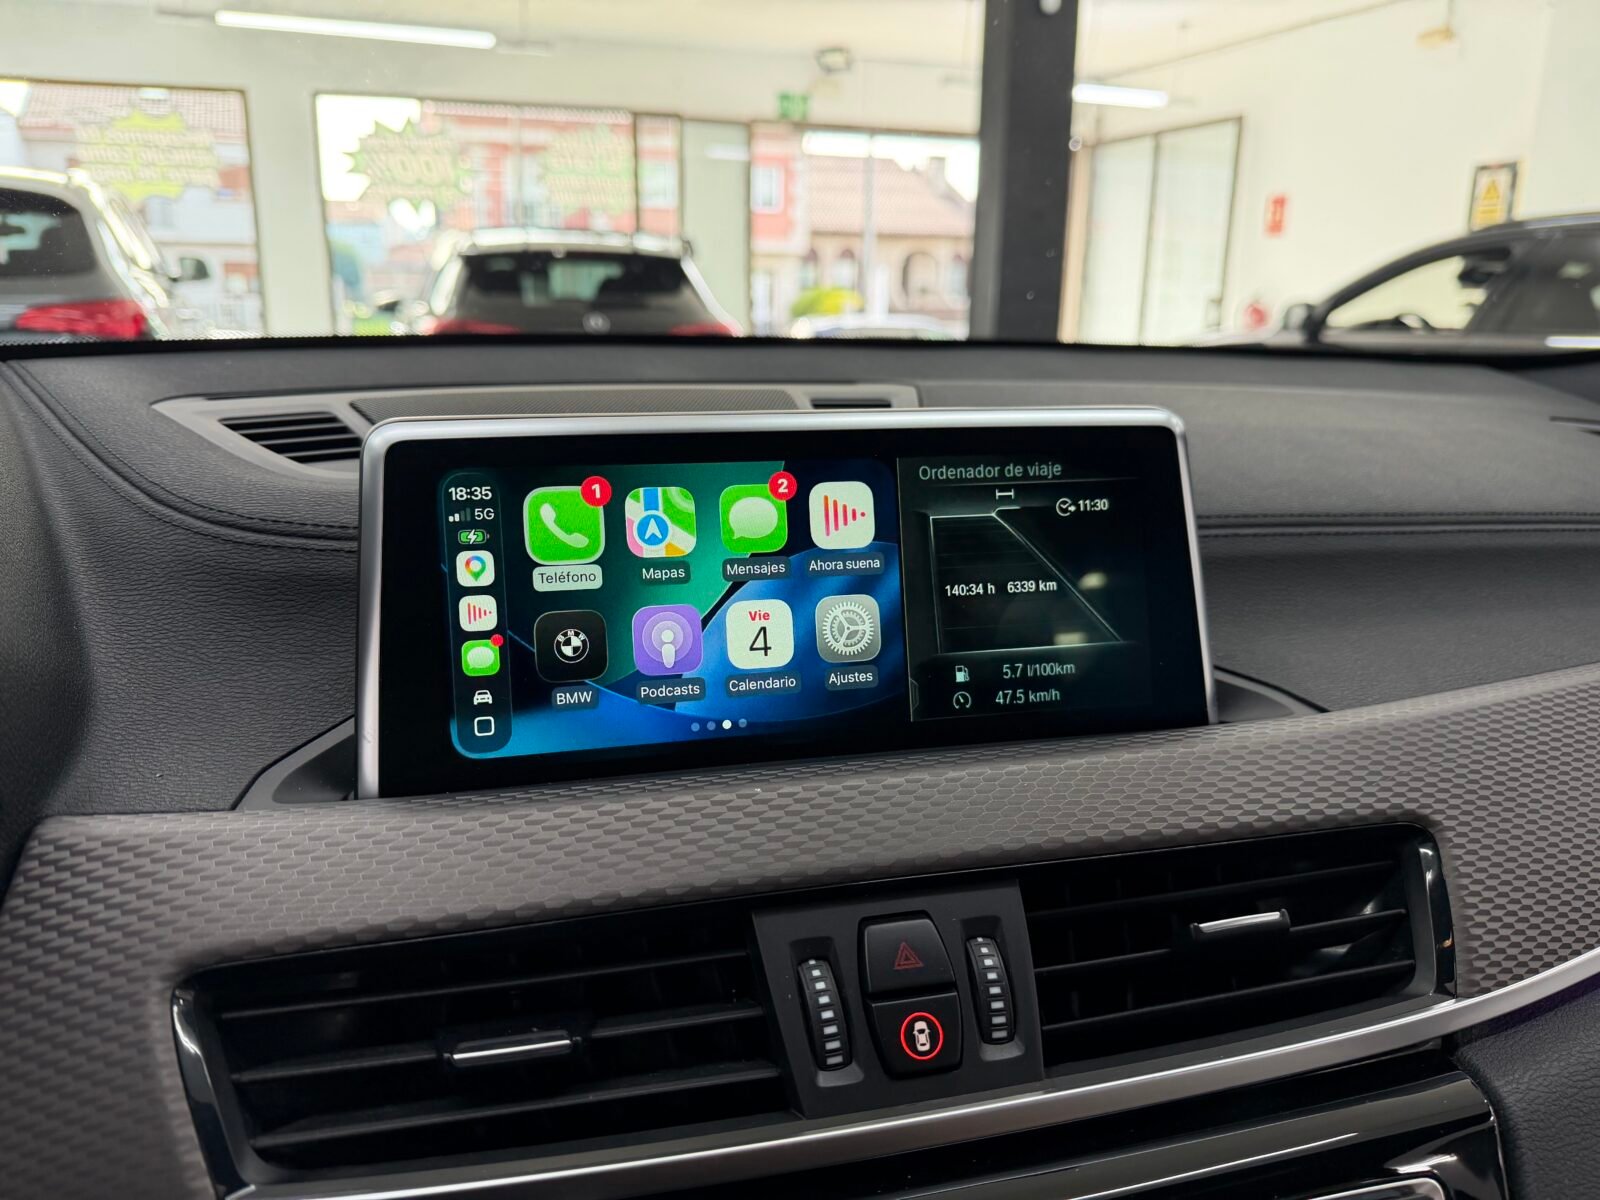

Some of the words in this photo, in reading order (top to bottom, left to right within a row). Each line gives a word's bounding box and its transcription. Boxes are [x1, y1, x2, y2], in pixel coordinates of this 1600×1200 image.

[918, 465, 1000, 481] Ordenador
[1004, 463, 1023, 478] de
[1027, 461, 1062, 479] viaje
[591, 483, 601, 499] 1
[777, 478, 789, 493] 2
[448, 486, 493, 501] 18:35
[1077, 498, 1109, 512] 11:30
[474, 508, 495, 520] 5G
[726, 562, 786, 577] Mensajes
[809, 558, 844, 571] Ahora
[845, 558, 881, 570] suena
[538, 572, 597, 585] Teléfono
[642, 567, 686, 582] Mapas
[945, 584, 984, 597] 140:34
[987, 583, 996, 595] h
[1007, 580, 1036, 593] 6339
[1038, 579, 1058, 592] km
[748, 609, 771, 622] Vie
[749, 626, 772, 657] 4
[828, 670, 874, 686] Ajustes
[1002, 663, 1024, 679] 5.7
[1026, 662, 1076, 677] l/100km
[640, 683, 701, 699] Podcasts
[729, 675, 797, 693] Calendario
[556, 691, 593, 706] BMW
[995, 688, 1025, 706] 47.5
[1028, 688, 1061, 702] km/h
